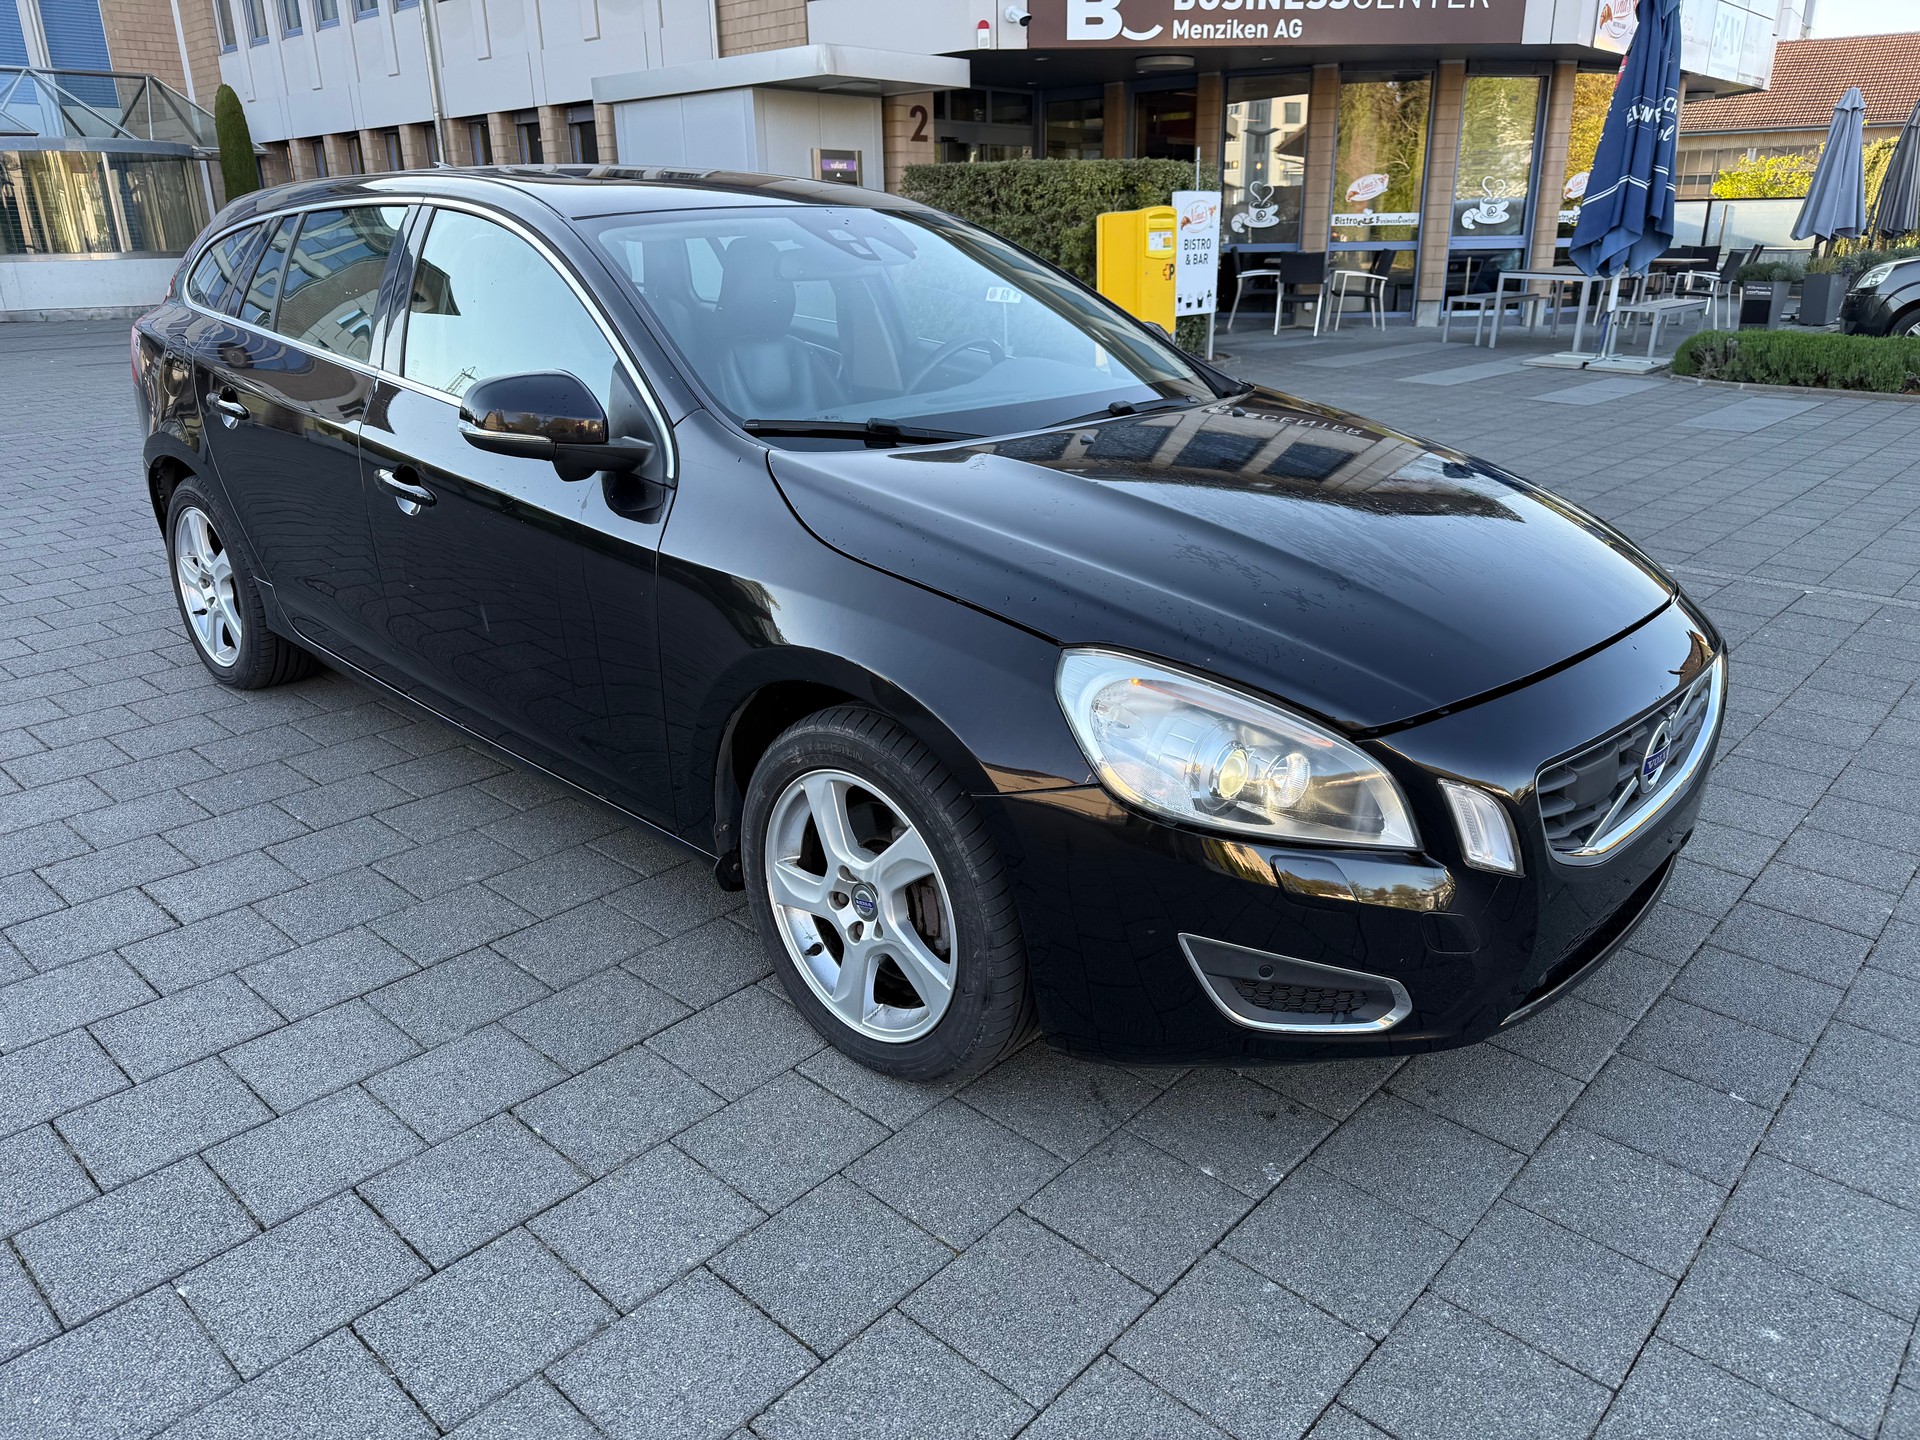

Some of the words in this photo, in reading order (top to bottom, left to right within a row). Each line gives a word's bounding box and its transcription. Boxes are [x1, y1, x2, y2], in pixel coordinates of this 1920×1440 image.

[1172, 19, 1268, 39] Menziken
[1273, 18, 1303, 39] AG
[910, 104, 928, 142] 2
[1334, 216, 1359, 225] Bistro
[1184, 238, 1212, 251] BISTRO
[1185, 254, 1191, 266] &
[1193, 253, 1208, 265] BAR
